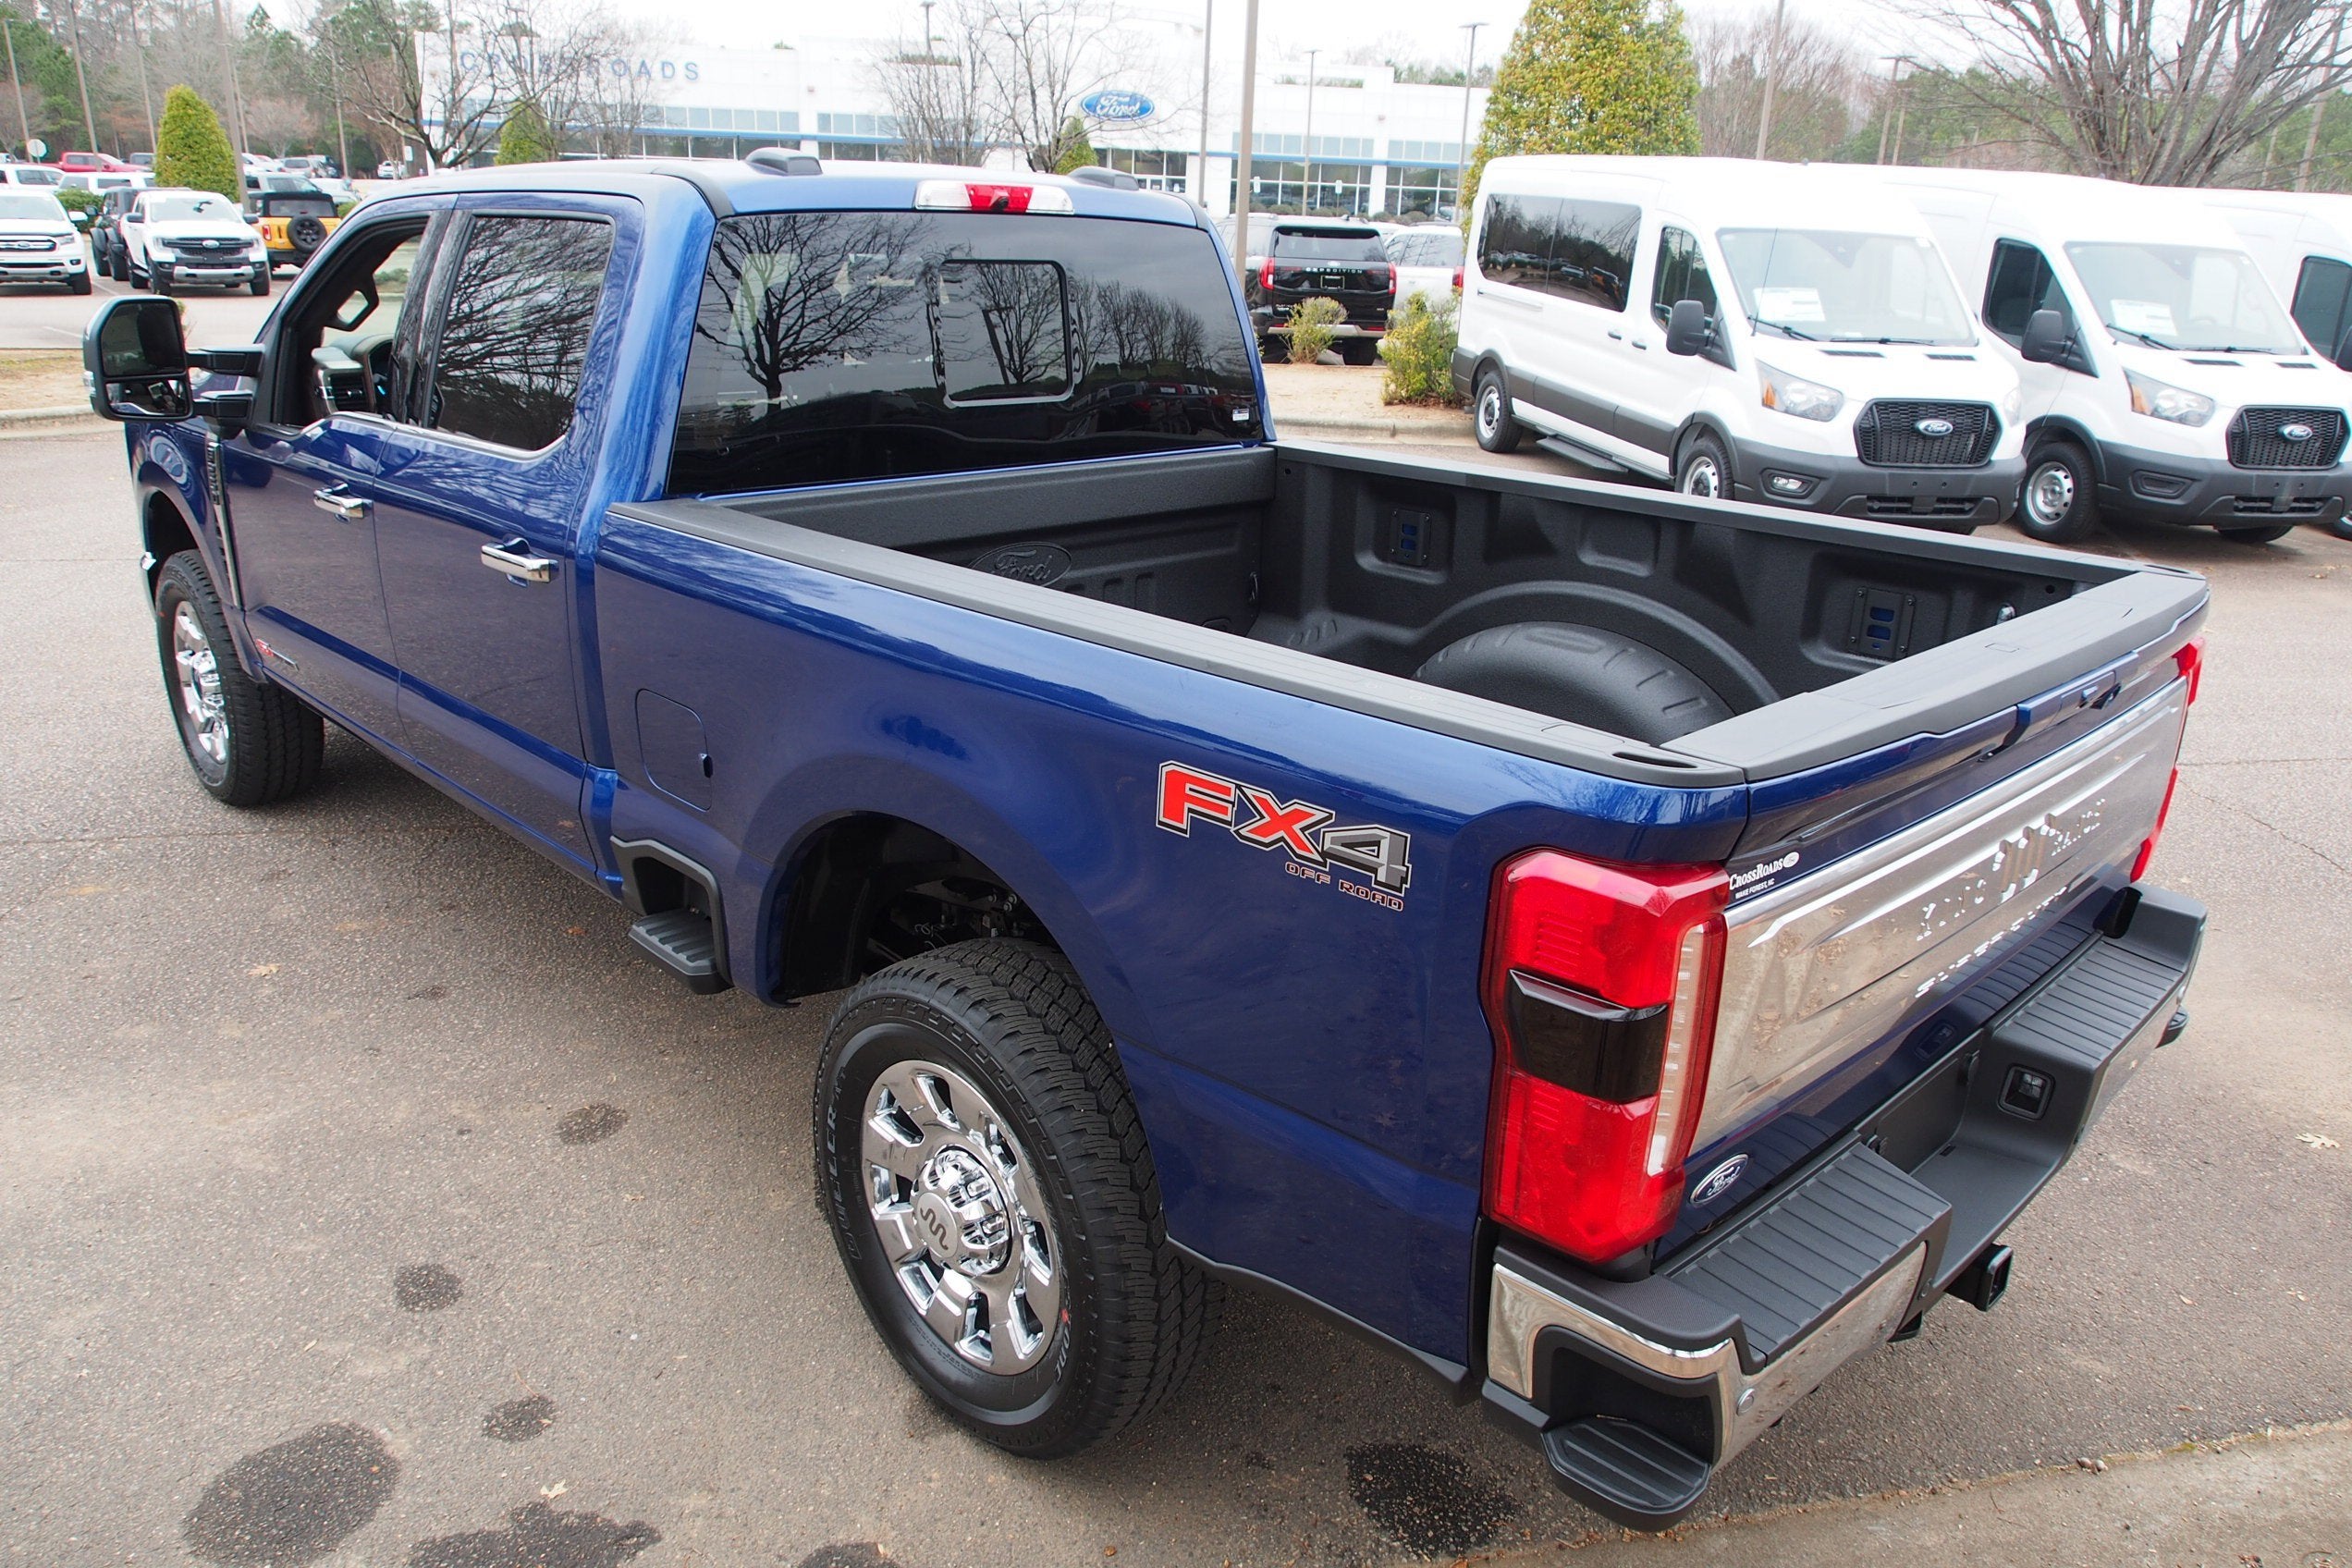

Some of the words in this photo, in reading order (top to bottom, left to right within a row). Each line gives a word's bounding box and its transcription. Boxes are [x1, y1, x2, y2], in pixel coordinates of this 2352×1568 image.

[1305, 266, 1362, 275] EXPEDITION
[991, 550, 1052, 581] Ford
[1156, 760, 1413, 897] FX4
[1285, 862, 1331, 885] OFF
[1339, 879, 1404, 912] ROAD
